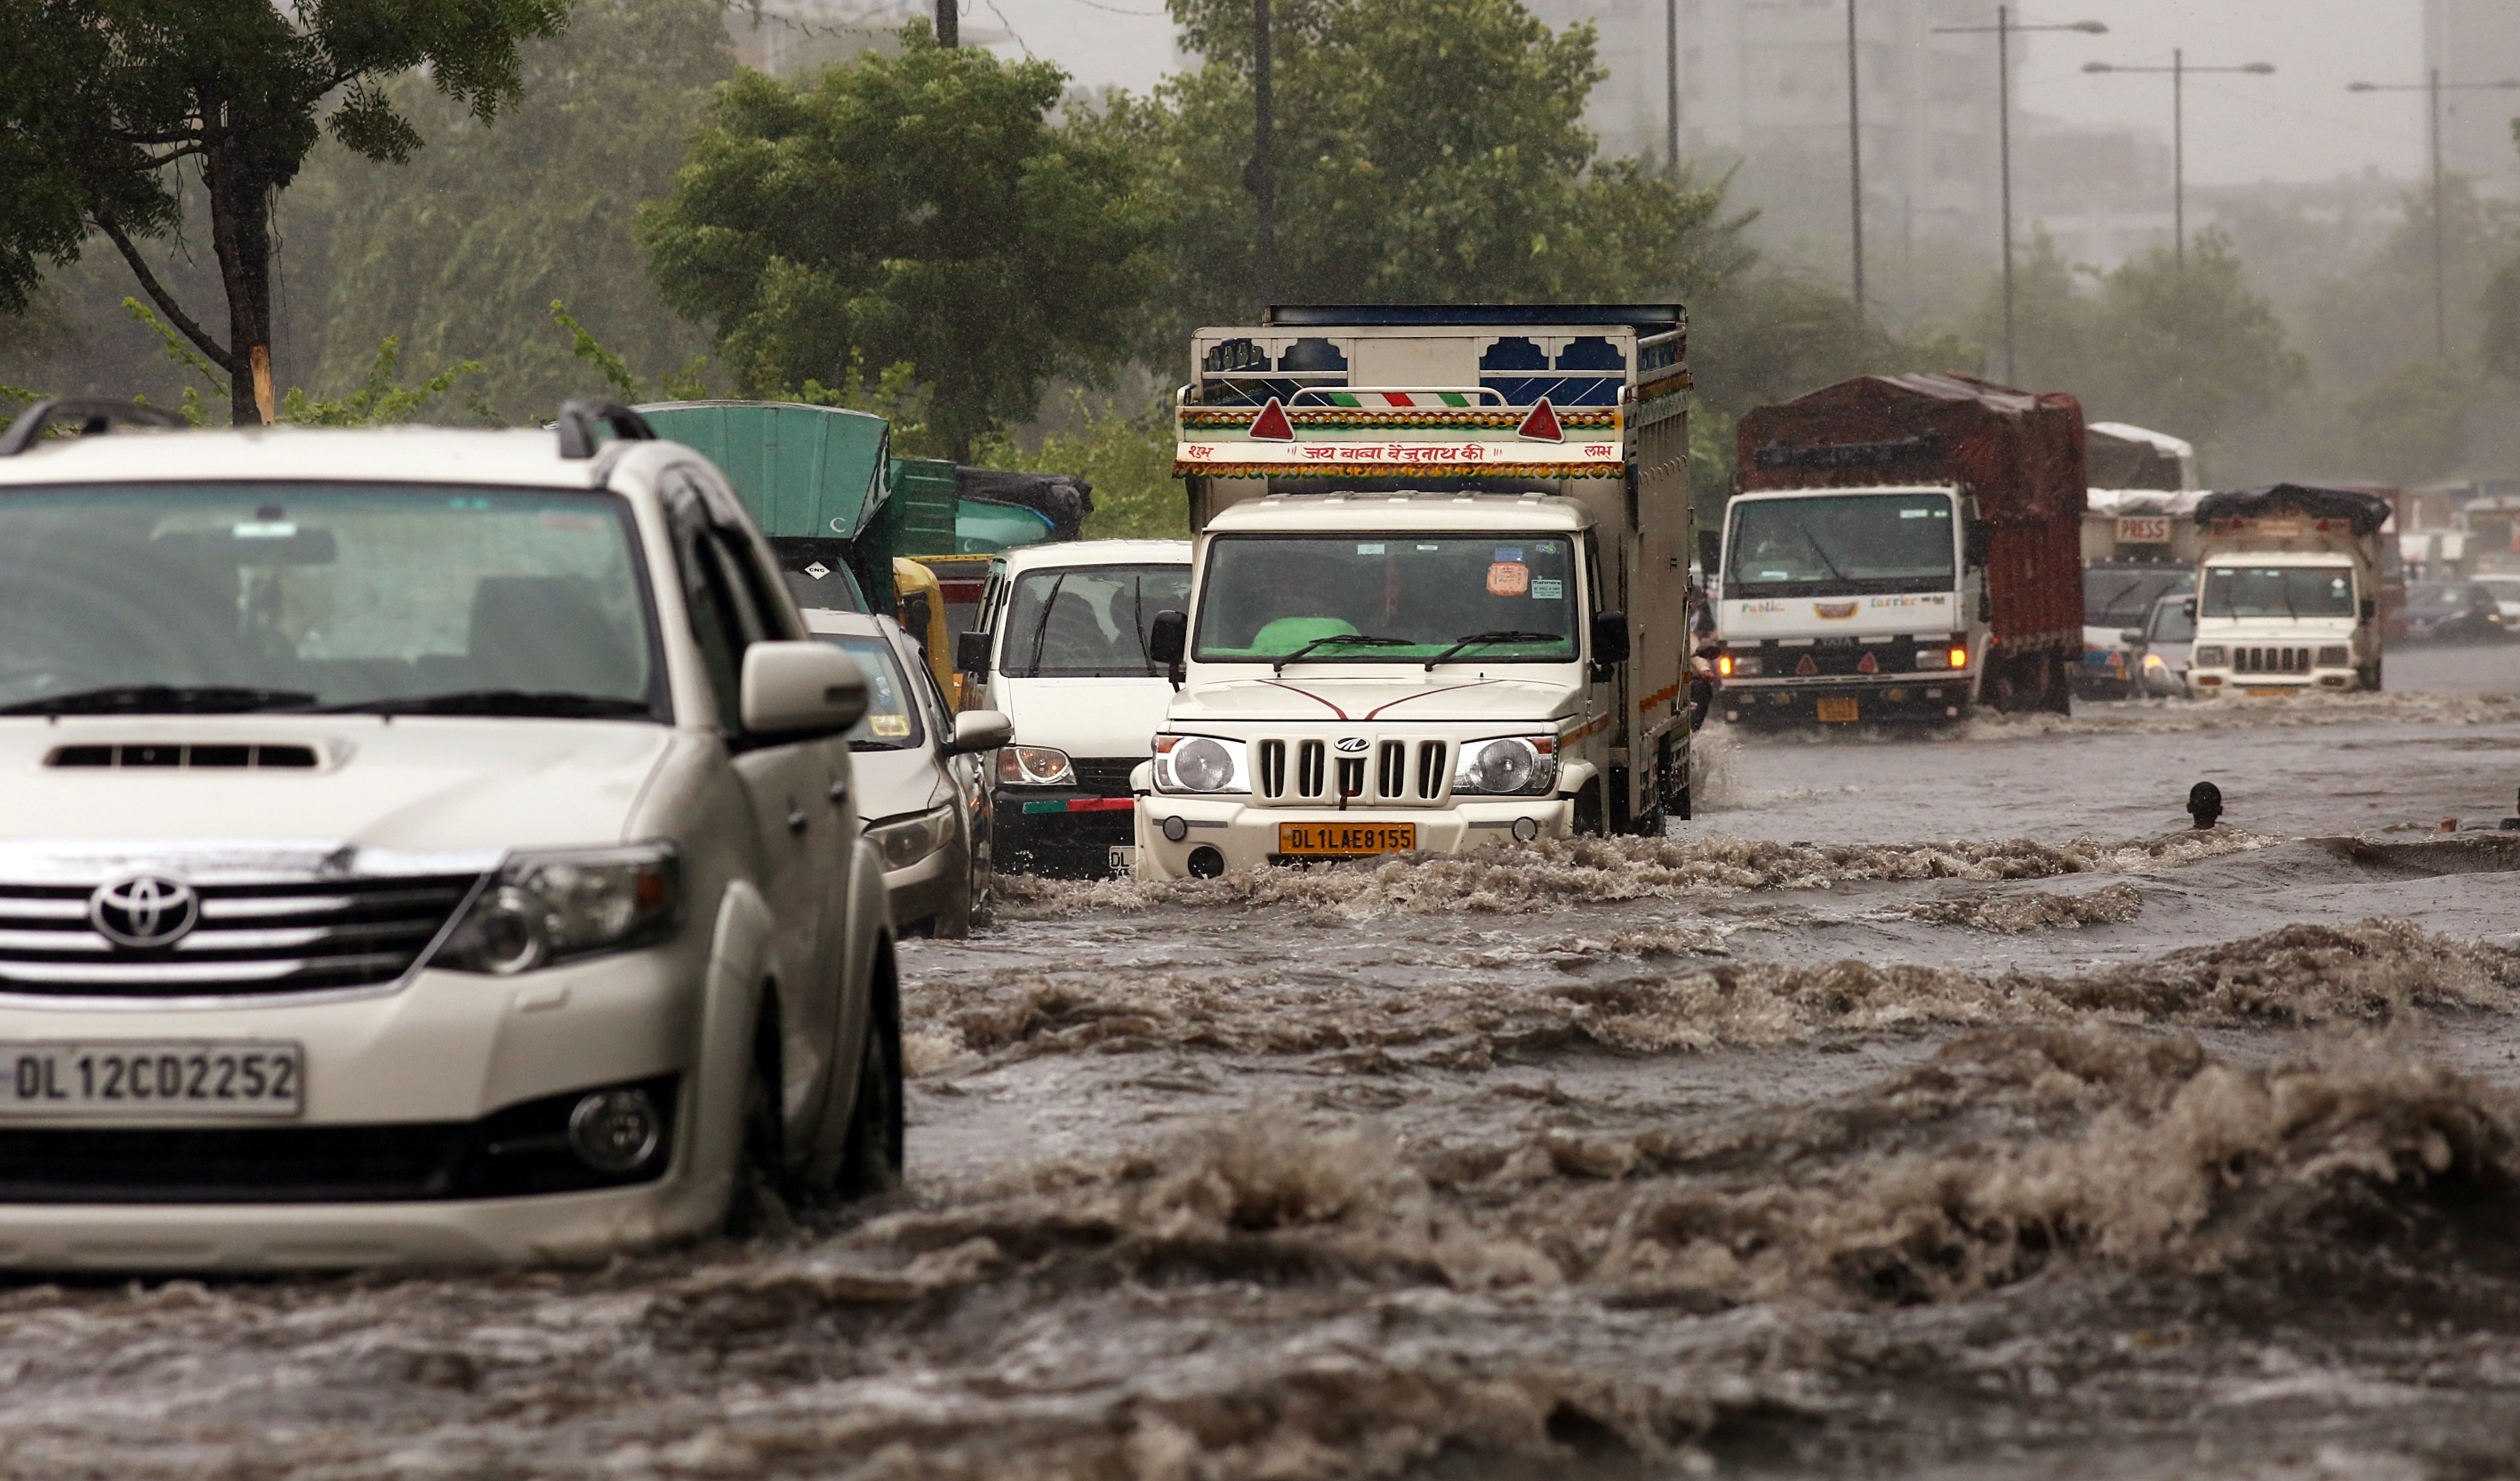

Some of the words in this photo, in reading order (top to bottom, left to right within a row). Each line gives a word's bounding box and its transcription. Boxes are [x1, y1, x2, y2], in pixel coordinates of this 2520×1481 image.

[1301, 447, 1337, 460] जय
[1339, 447, 1384, 460] बाबा
[1461, 443, 1486, 460] की
[2122, 519, 2166, 538] PRESS
[1292, 829, 1411, 849] DL1LAE8155
[1111, 851, 1130, 867] DL
[15, 1055, 293, 1099] DL12CD2252
